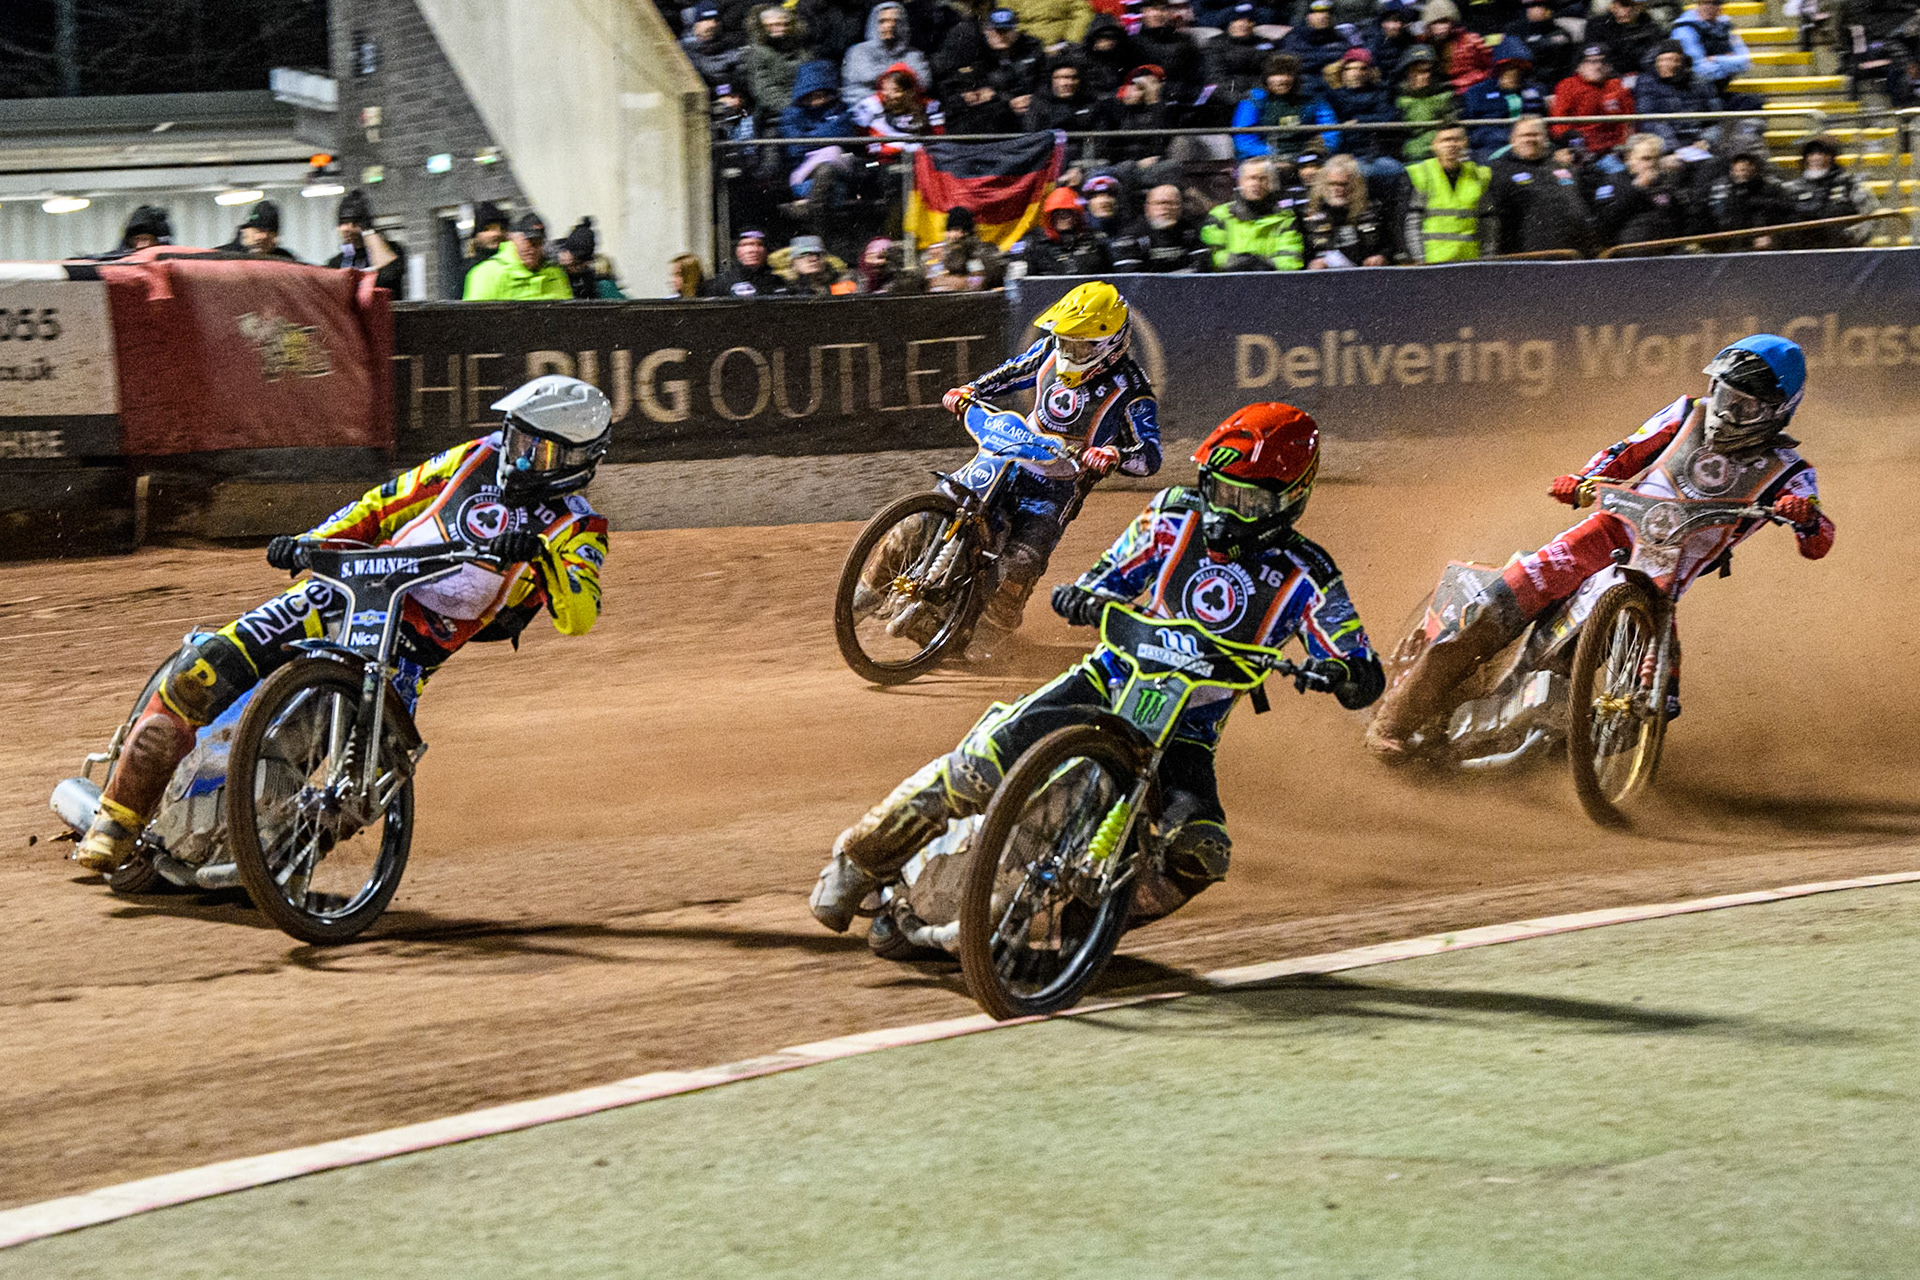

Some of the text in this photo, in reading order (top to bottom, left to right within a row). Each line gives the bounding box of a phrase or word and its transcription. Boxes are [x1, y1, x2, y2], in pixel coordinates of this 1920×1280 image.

[1235, 326, 1555, 399] Delivering
[533, 502, 557, 525] 10
[1258, 564, 1285, 588] 16
[239, 580, 334, 645] Nice
[350, 631, 380, 646] Nice
